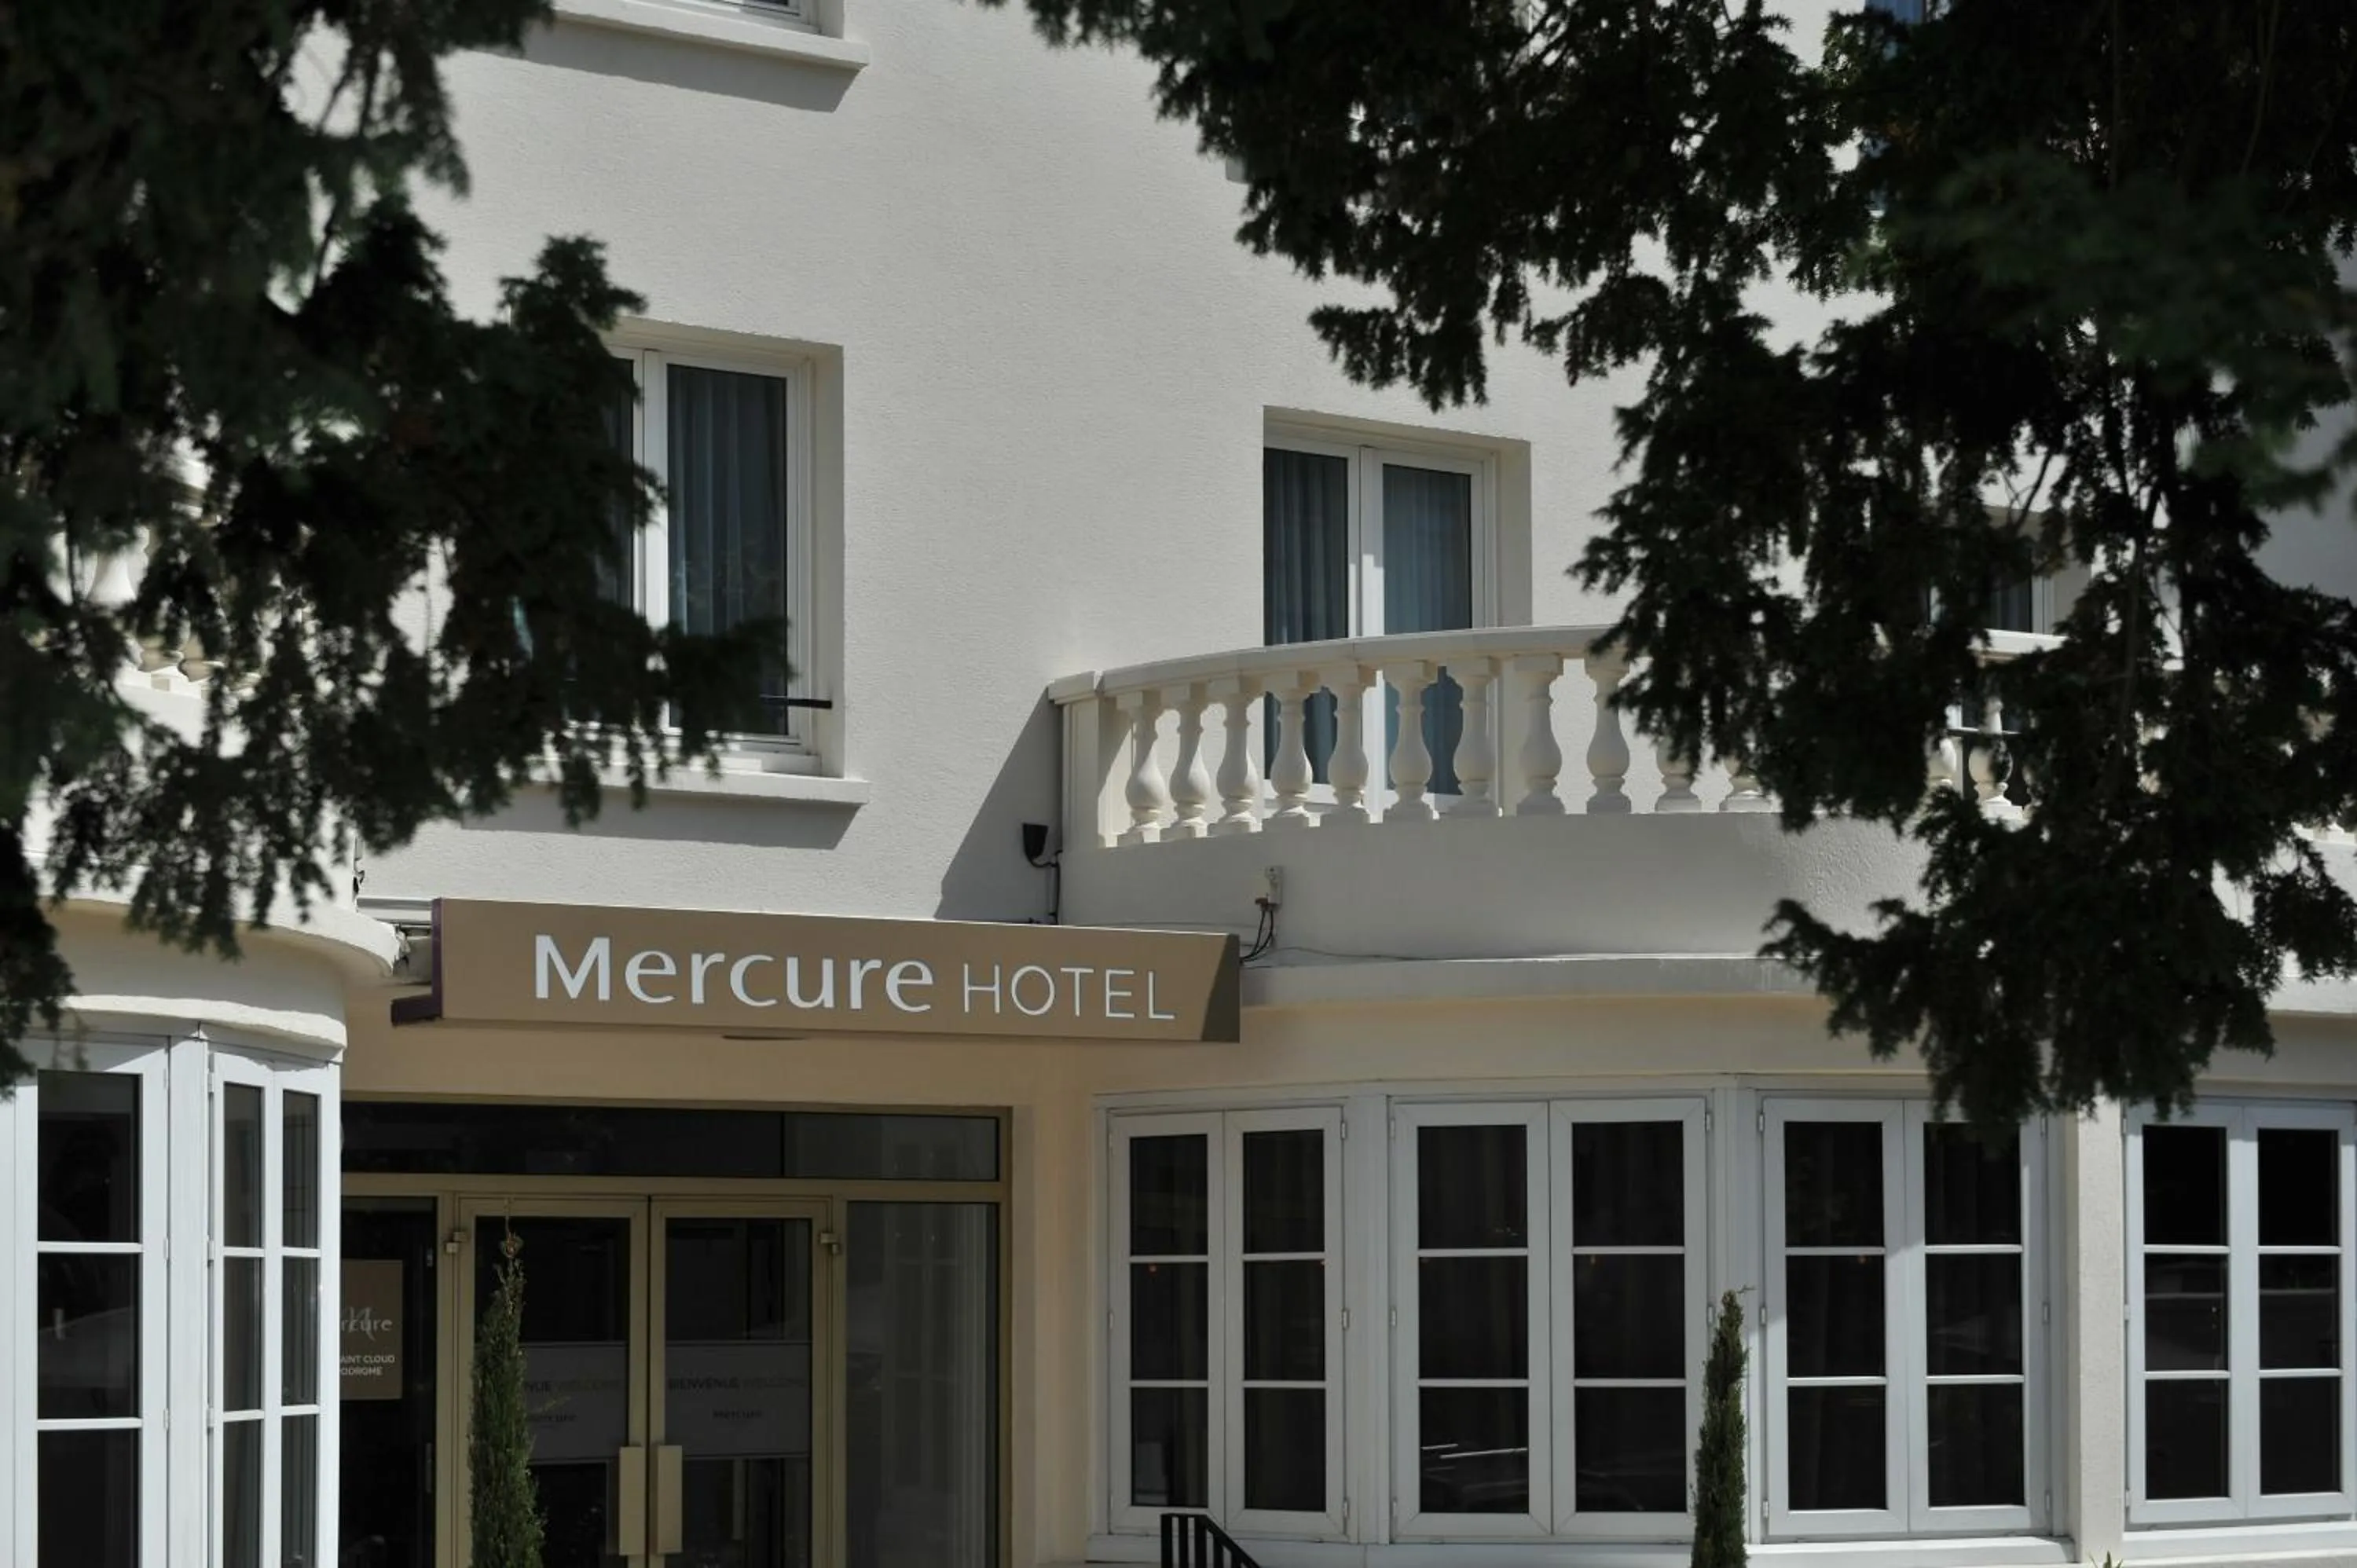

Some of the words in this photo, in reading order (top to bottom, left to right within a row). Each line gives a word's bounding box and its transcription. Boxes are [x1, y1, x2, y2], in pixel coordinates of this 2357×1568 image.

[533, 933, 933, 1013] Mercure
[962, 963, 1175, 1020] HOTEL
[340, 1318, 394, 1332] rcure
[340, 1354, 362, 1365] AINT
[363, 1354, 396, 1364] CLOUD
[340, 1365, 384, 1376] ODROME
